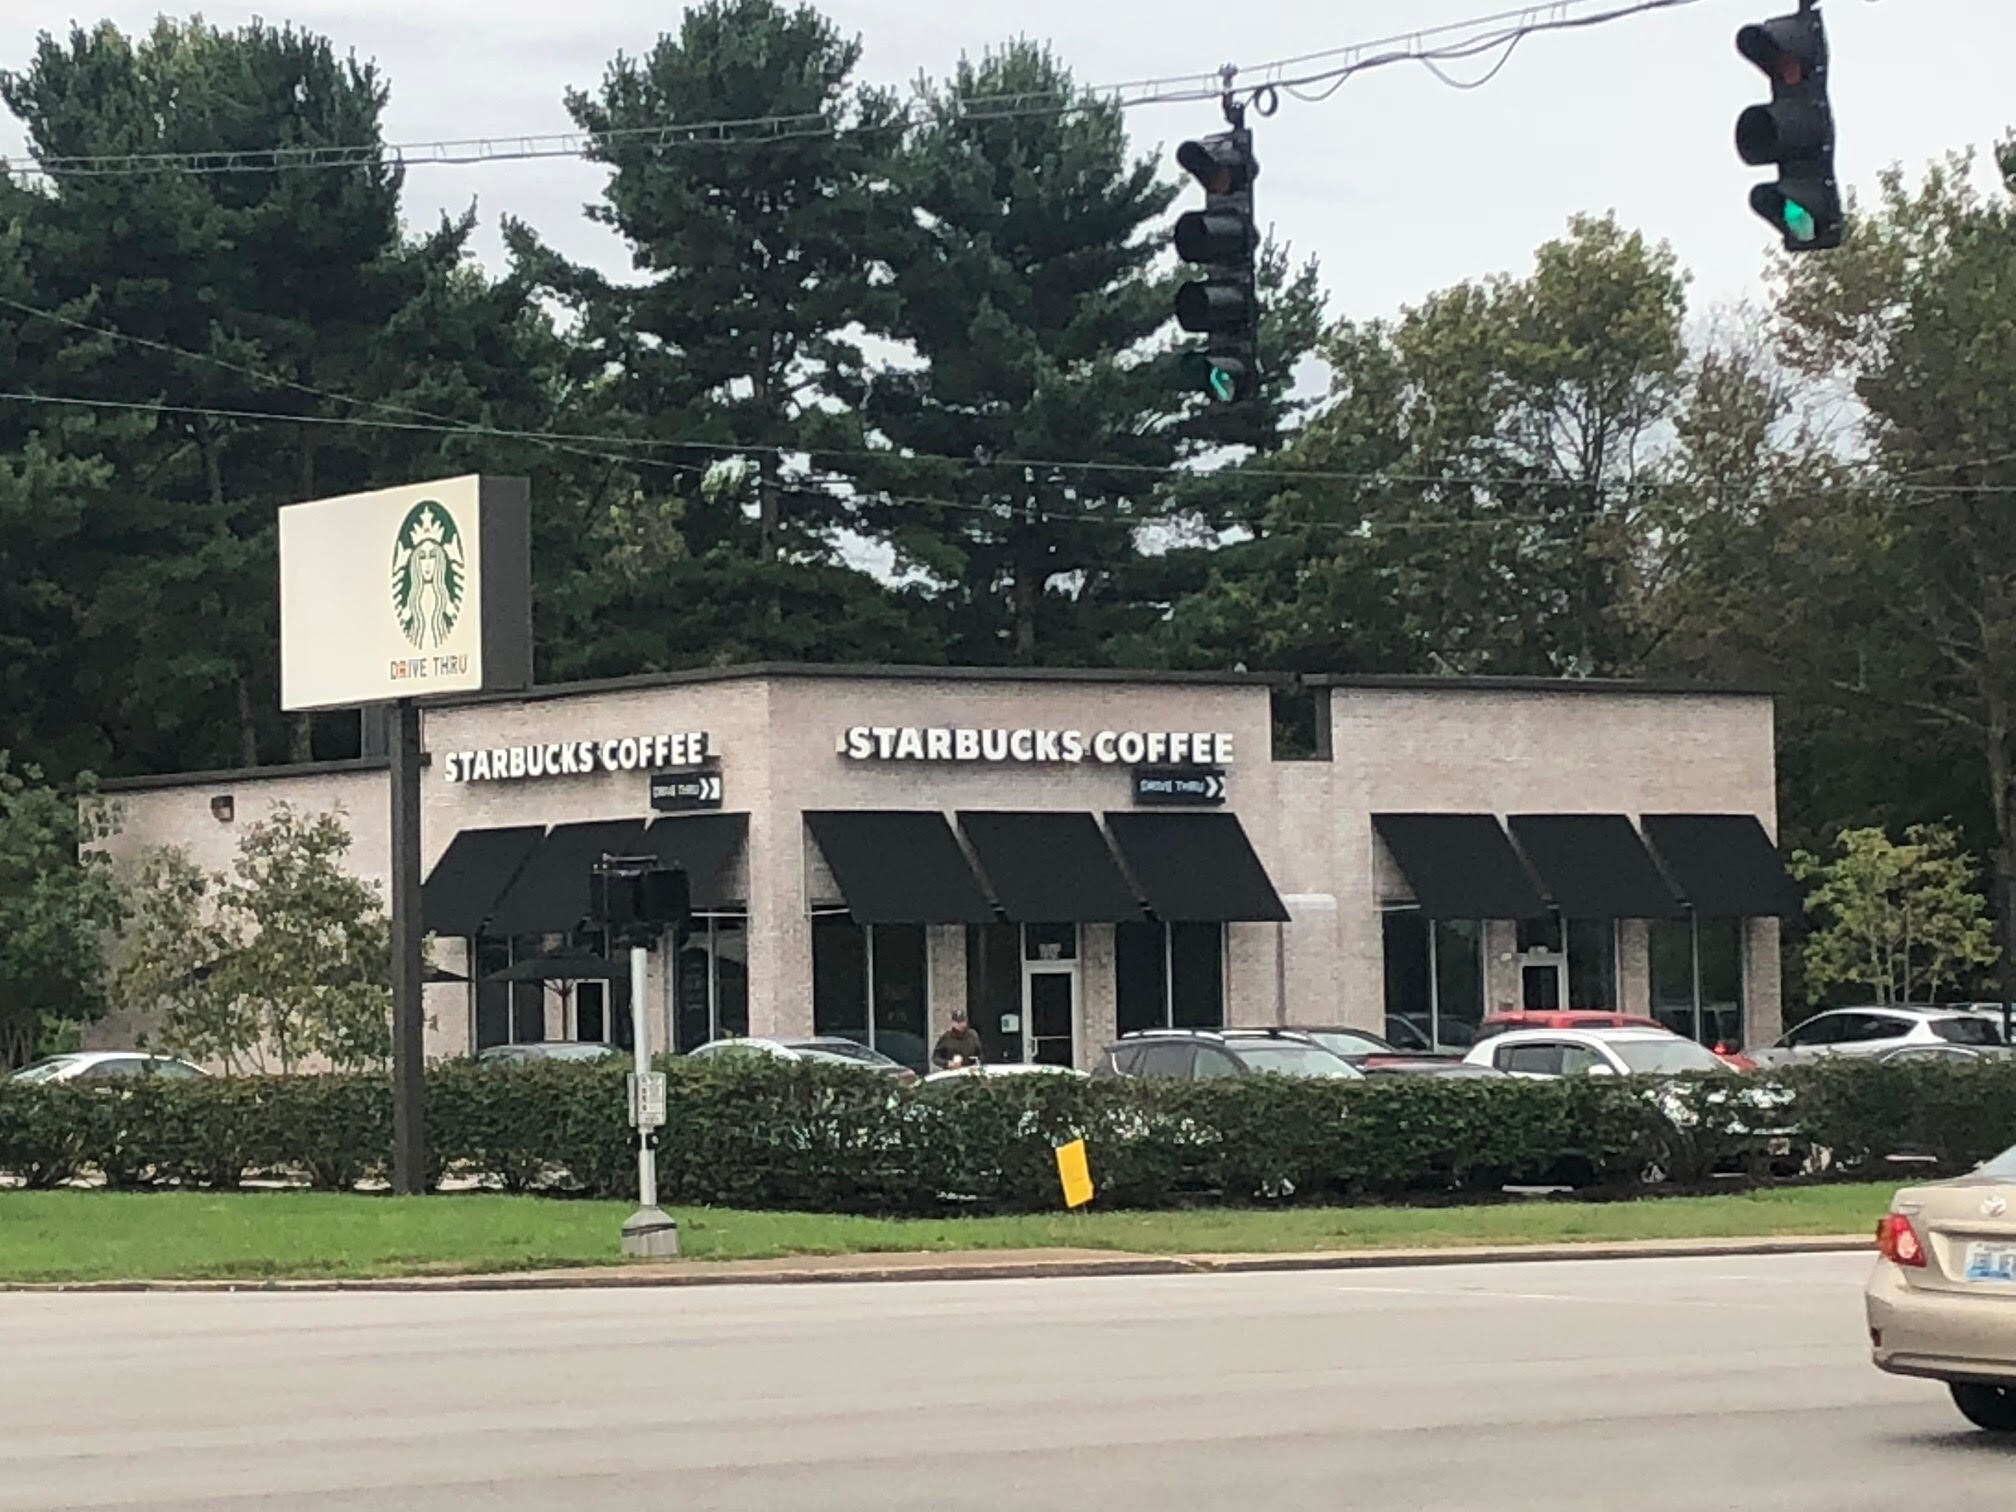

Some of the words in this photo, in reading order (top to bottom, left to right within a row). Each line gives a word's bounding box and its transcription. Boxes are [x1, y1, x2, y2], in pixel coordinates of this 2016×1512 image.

[390, 658, 427, 680] DRIVE
[433, 655, 467, 676] THRU
[445, 742, 593, 782] STARBUCKS
[601, 732, 703, 771] COFFEE
[848, 726, 1085, 762] STARBUCKS
[1094, 731, 1234, 764] COFFEE
